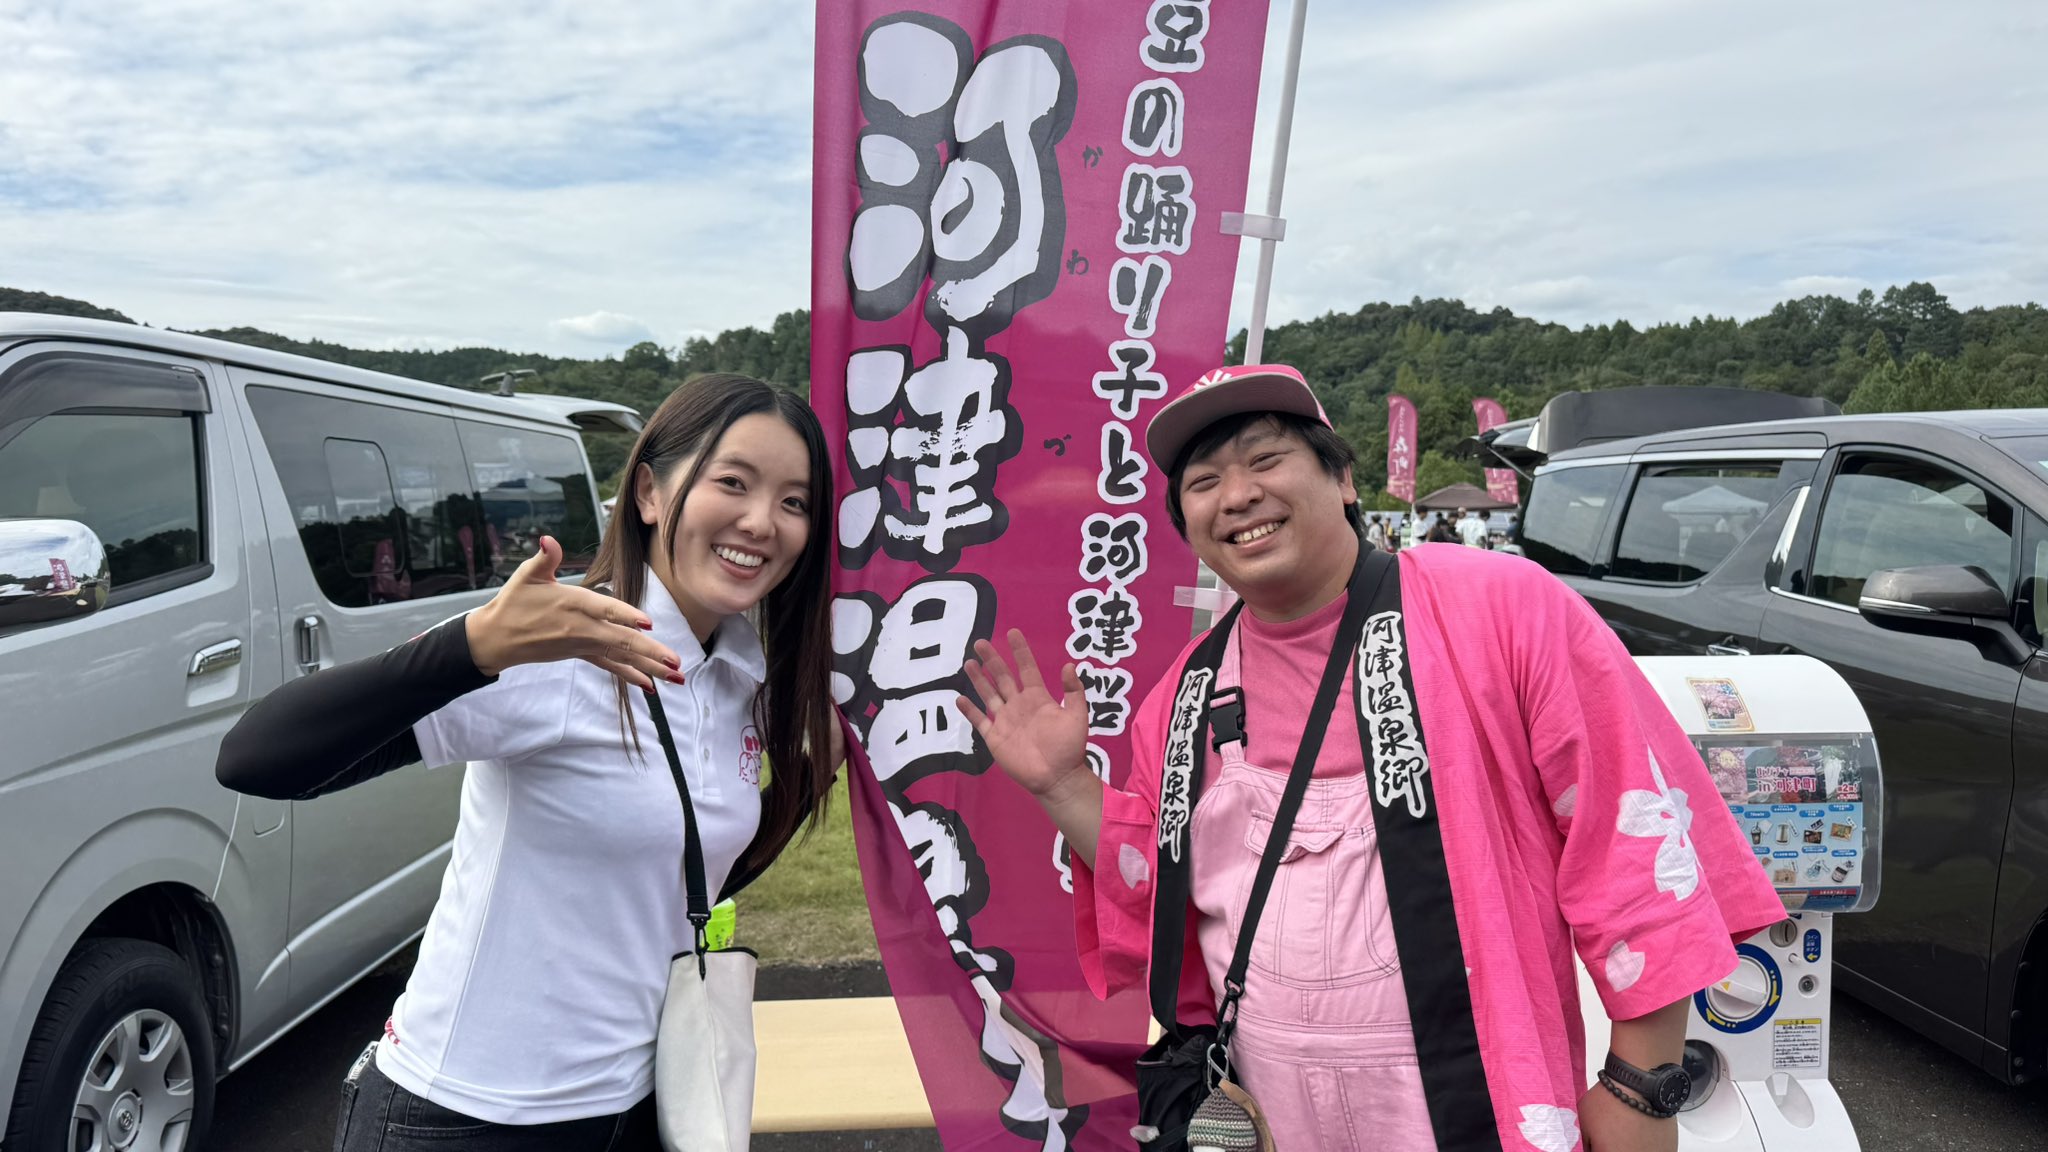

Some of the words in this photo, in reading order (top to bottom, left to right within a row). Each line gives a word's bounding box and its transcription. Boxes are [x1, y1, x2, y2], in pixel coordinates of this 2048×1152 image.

[1159, 668, 1212, 862] 河津温泉郷
[1360, 612, 1427, 816] 河津温泉郷
